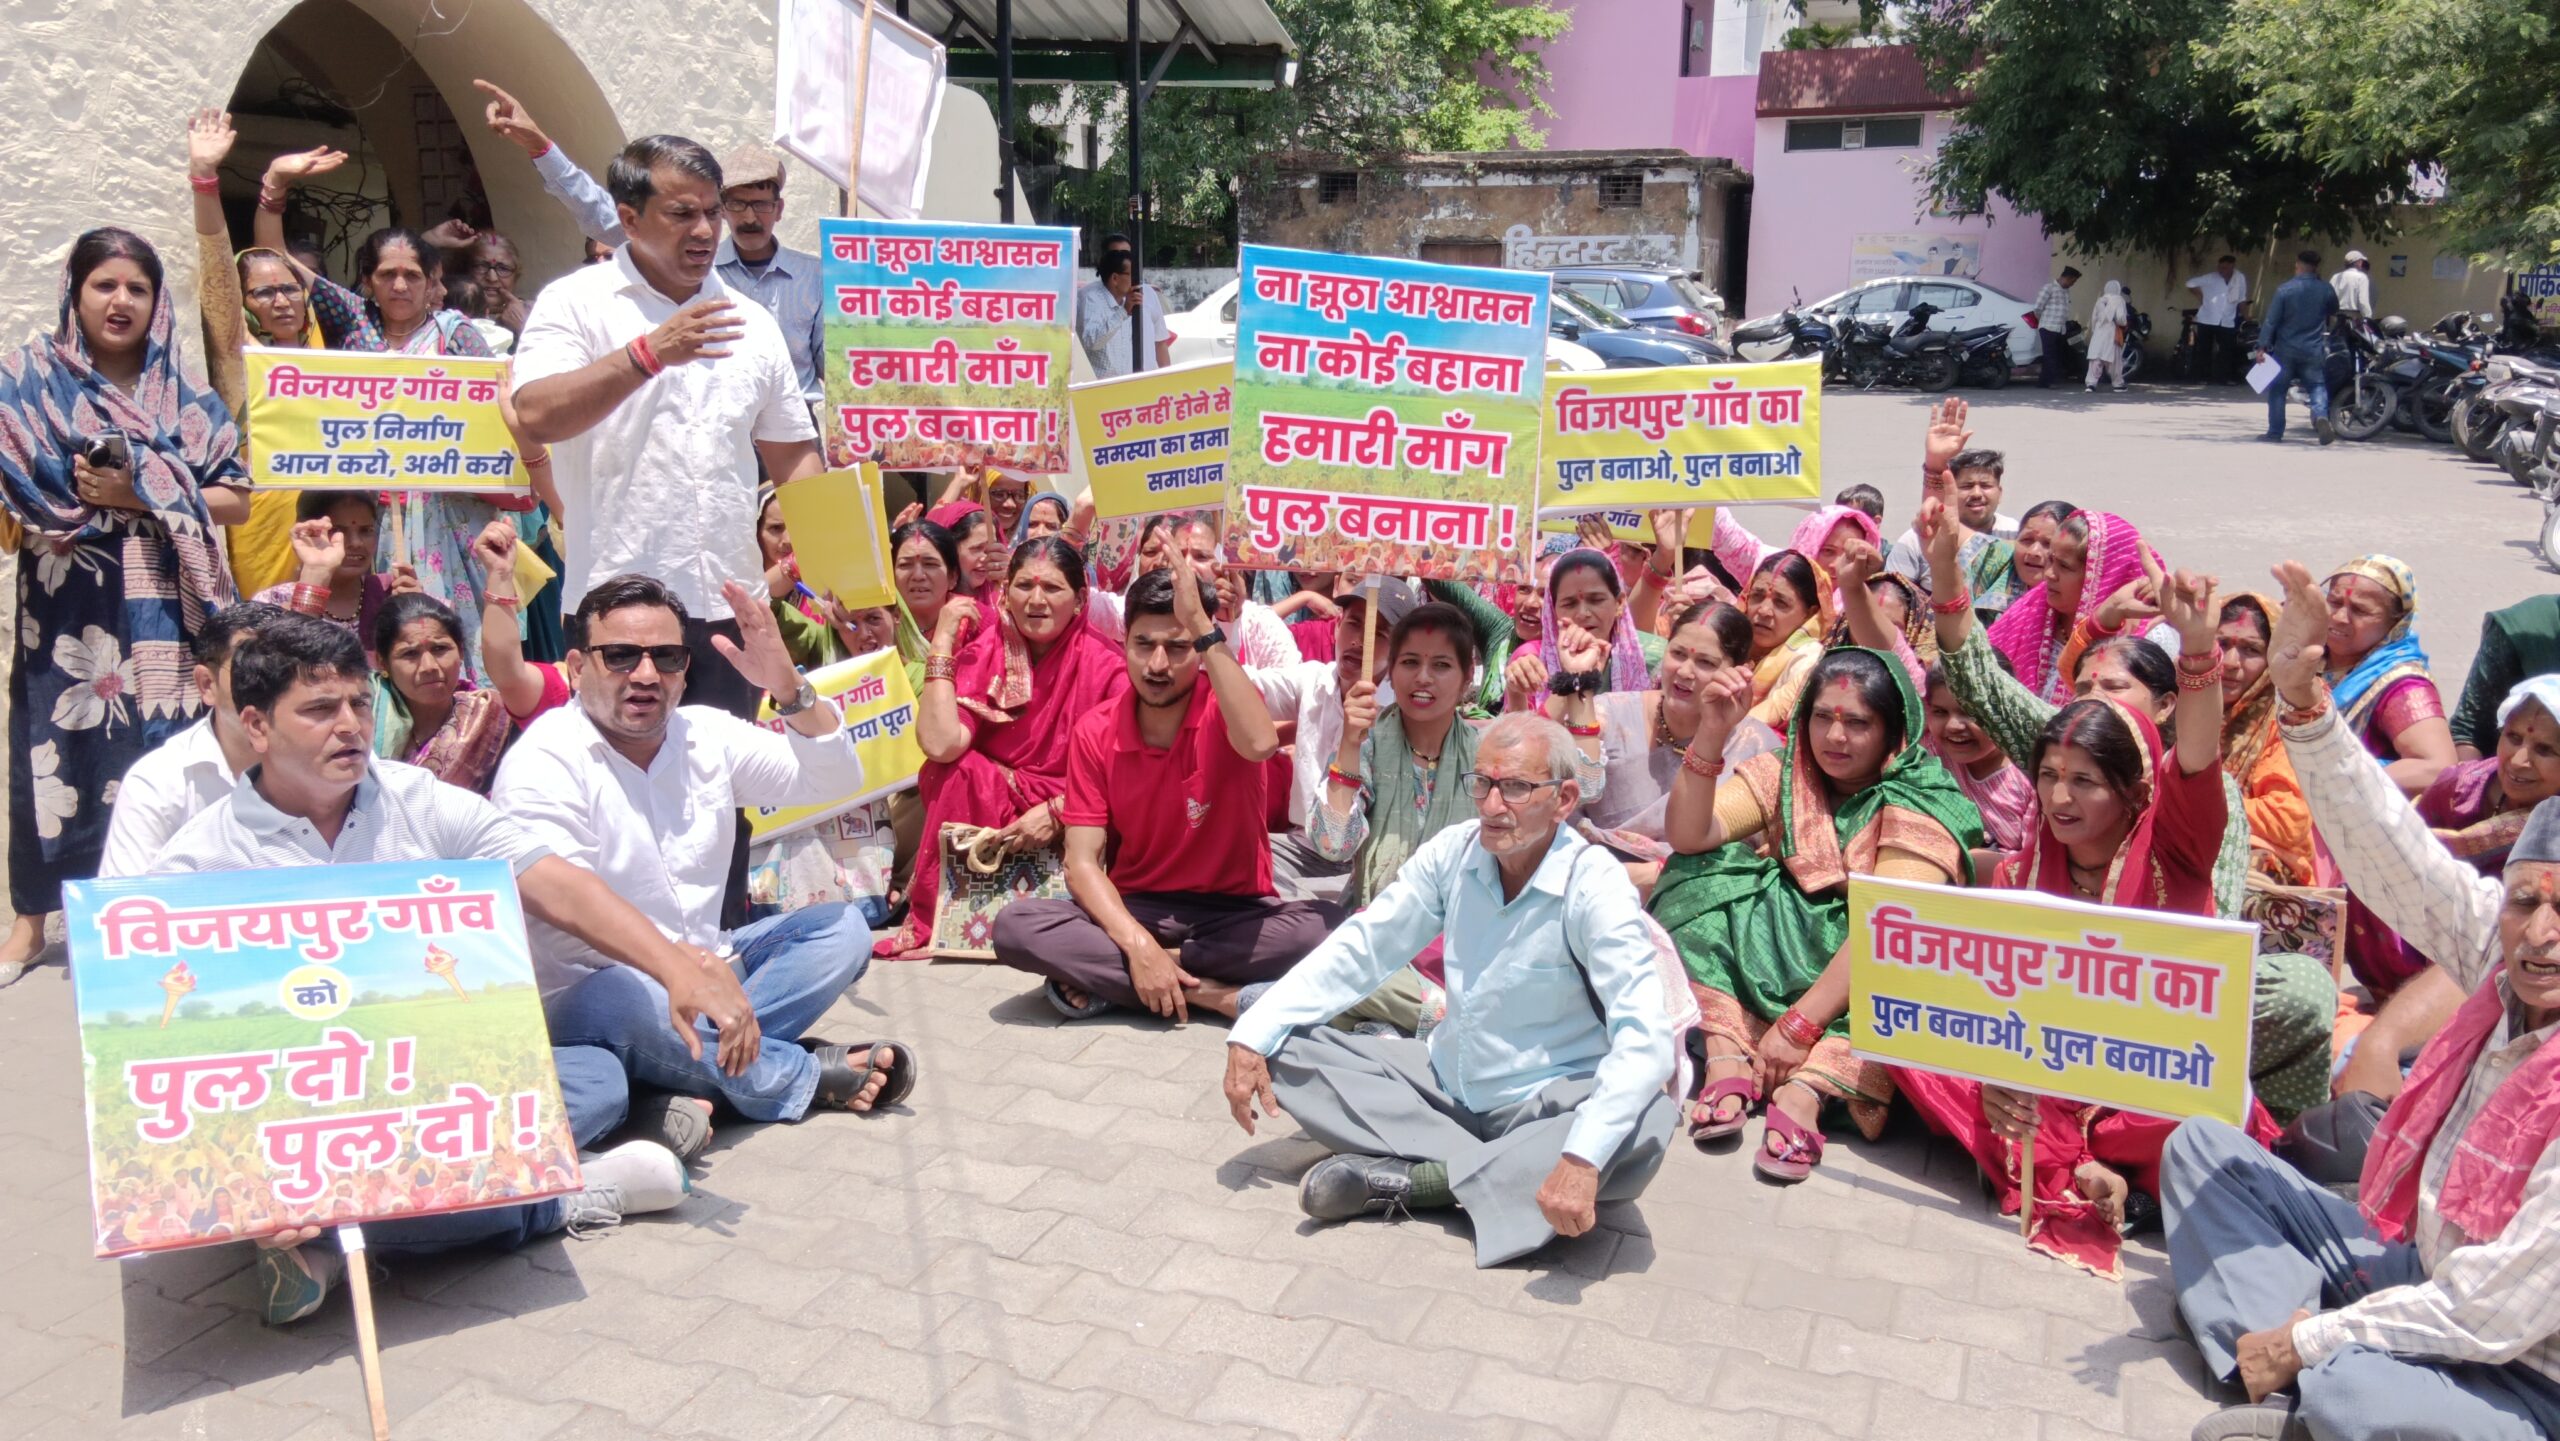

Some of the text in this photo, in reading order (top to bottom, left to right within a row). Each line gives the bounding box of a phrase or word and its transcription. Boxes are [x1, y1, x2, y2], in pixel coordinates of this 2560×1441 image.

[833, 237, 1060, 272] ना झूठा आश्वासन
[838, 281, 1056, 322] ना कोई बहाना
[1256, 269, 1533, 325] ना झूठा आश्वासन
[849, 338, 1048, 386] हमारी माँग
[1258, 332, 1524, 393] ना कोई बहाना
[268, 365, 498, 409] विजयपुर गाँव क
[321, 414, 464, 448] पुल निर्माण
[841, 408, 908, 453] पुल
[916, 410, 1038, 442] बनाना
[1101, 387, 1231, 437] पुल नहीं होने से
[1557, 388, 1686, 440] विजयपुर
[1757, 390, 1802, 423] का
[272, 449, 514, 477] आज करो, अभी करो
[1094, 439, 1156, 465] समस्या
[1160, 434, 1185, 455] का
[1263, 410, 1508, 475] हमारी माँग
[1147, 463, 1224, 491] समाधान
[1557, 446, 1801, 490] पुल बनाओ, पुल बनाओ
[1247, 489, 1330, 548] पुल
[1338, 496, 1489, 545] बनाना
[880, 705, 912, 736] पूरा
[101, 878, 494, 959] विजयपुर गाँव
[1871, 907, 2048, 997] विजयपुर
[2152, 959, 2221, 1015] का
[295, 979, 337, 1006] को
[1871, 995, 2214, 1088] पुल बनाओ, पुल बनाओ
[131, 1055, 272, 1138] पुल
[289, 1032, 367, 1104] दो
[265, 1110, 402, 1198] पुल
[418, 1091, 493, 1157] दो
